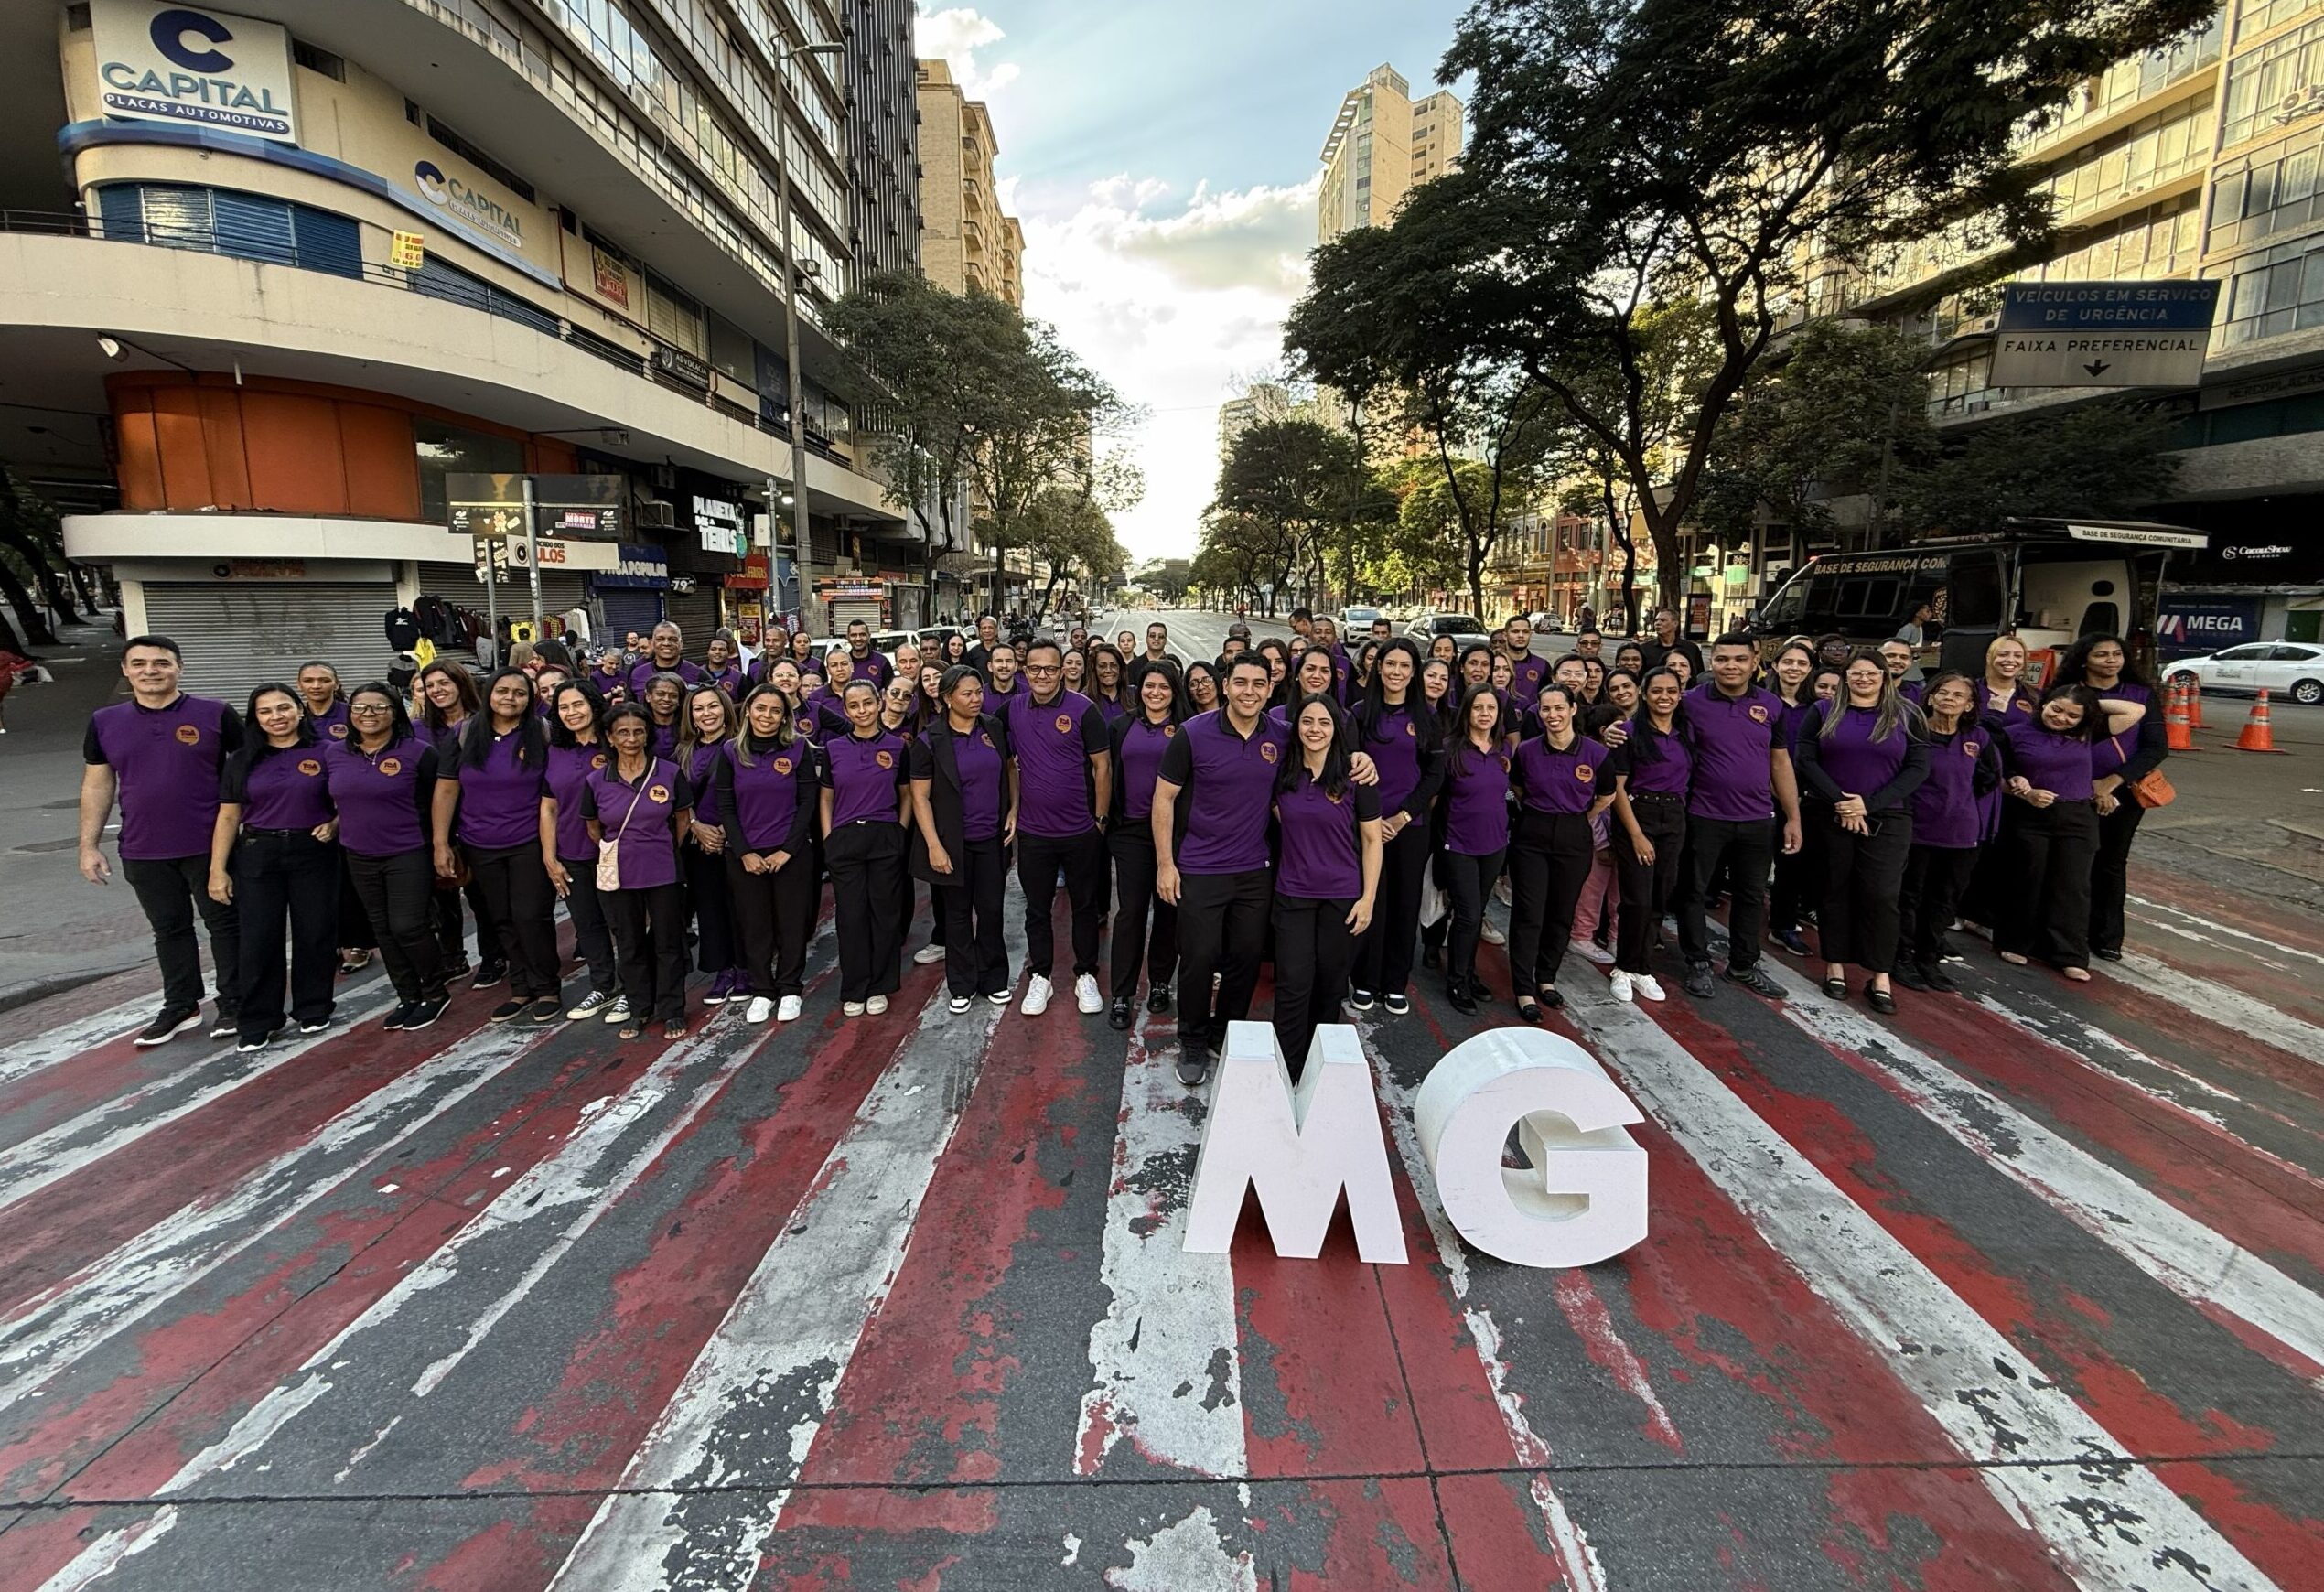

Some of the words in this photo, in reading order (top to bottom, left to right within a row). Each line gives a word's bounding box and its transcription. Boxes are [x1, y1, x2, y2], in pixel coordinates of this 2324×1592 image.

[102, 62, 288, 116] CAPITAL
[106, 95, 168, 113] PLACAS
[176, 105, 285, 131] AUTOMOTIVAS
[448, 178, 524, 240] CAPITAL
[2016, 285, 2098, 303] VEÍCULOS
[2105, 290, 2130, 302] EM
[2045, 309, 2068, 321] DE
[2079, 305, 2168, 321] URGÊNCIA
[2005, 340, 2056, 352] FAIXA
[2067, 339, 2199, 353] PREFERENCIAL
[693, 495, 737, 522] PLANETA
[565, 515, 596, 524] MORTE
[2110, 532, 2146, 542] SEGURANÇA
[2148, 534, 2192, 544] COMUNITÁRIA
[1814, 564, 1839, 575] BASE
[1840, 563, 1853, 573] DE
[1855, 558, 1918, 574] SEGURANÇA
[2187, 615, 2243, 631] MEGA
[1182, 1020, 1648, 1268] MG
